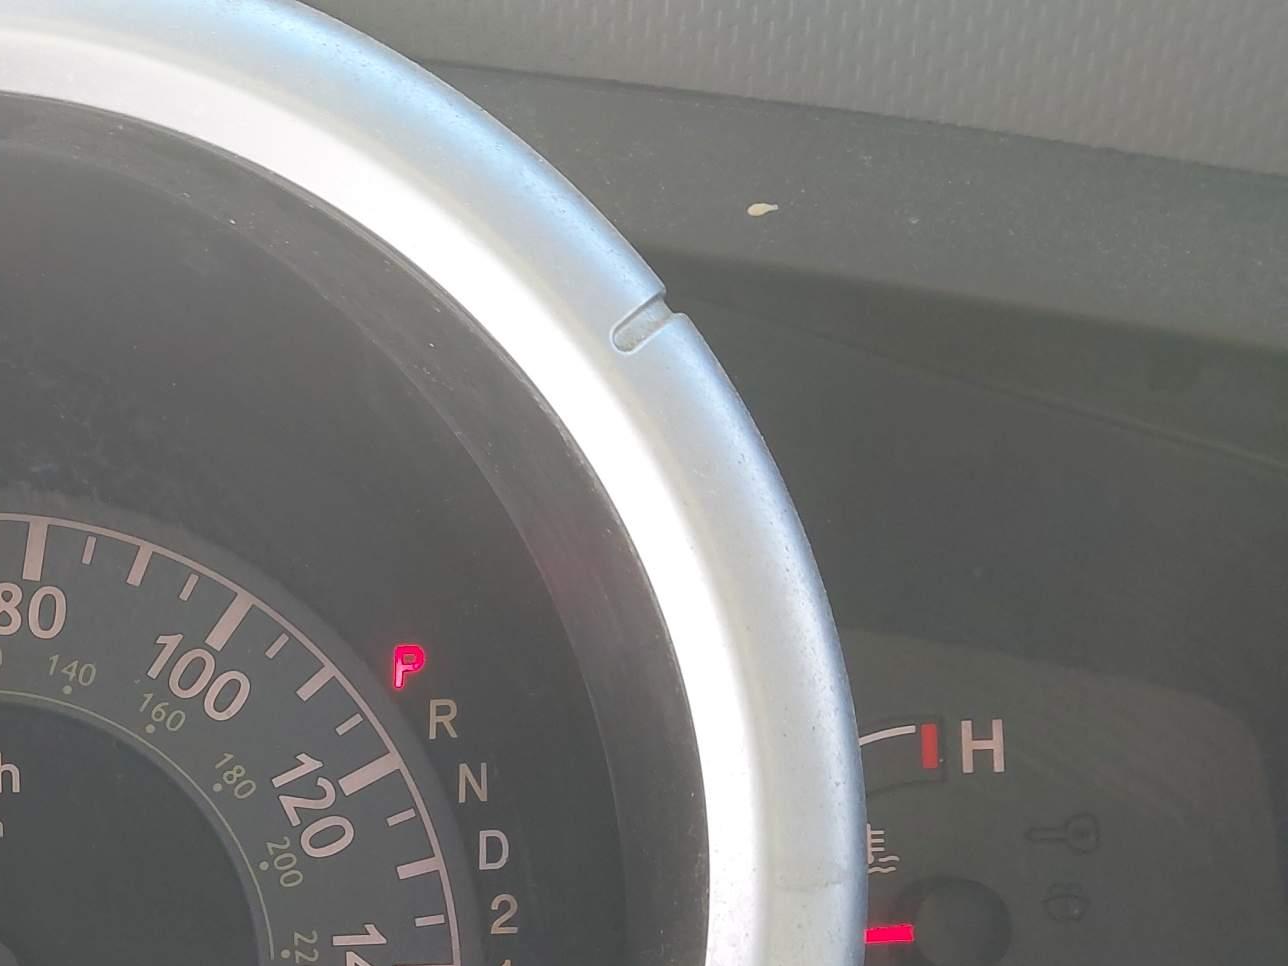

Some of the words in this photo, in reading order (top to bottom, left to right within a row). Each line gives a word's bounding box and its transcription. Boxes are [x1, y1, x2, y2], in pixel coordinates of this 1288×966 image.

[47, 653, 97, 687] 140
[146, 633, 251, 722] 100
[392, 644, 426, 690] P
[139, 692, 187, 733] 160
[428, 698, 459, 740] R
[961, 719, 1005, 773] H
[213, 752, 257, 799] 180
[458, 763, 488, 804] N
[271, 752, 355, 860] 120
[266, 836, 304, 889] 200
[479, 830, 509, 871] D
[490, 894, 519, 935] 2
